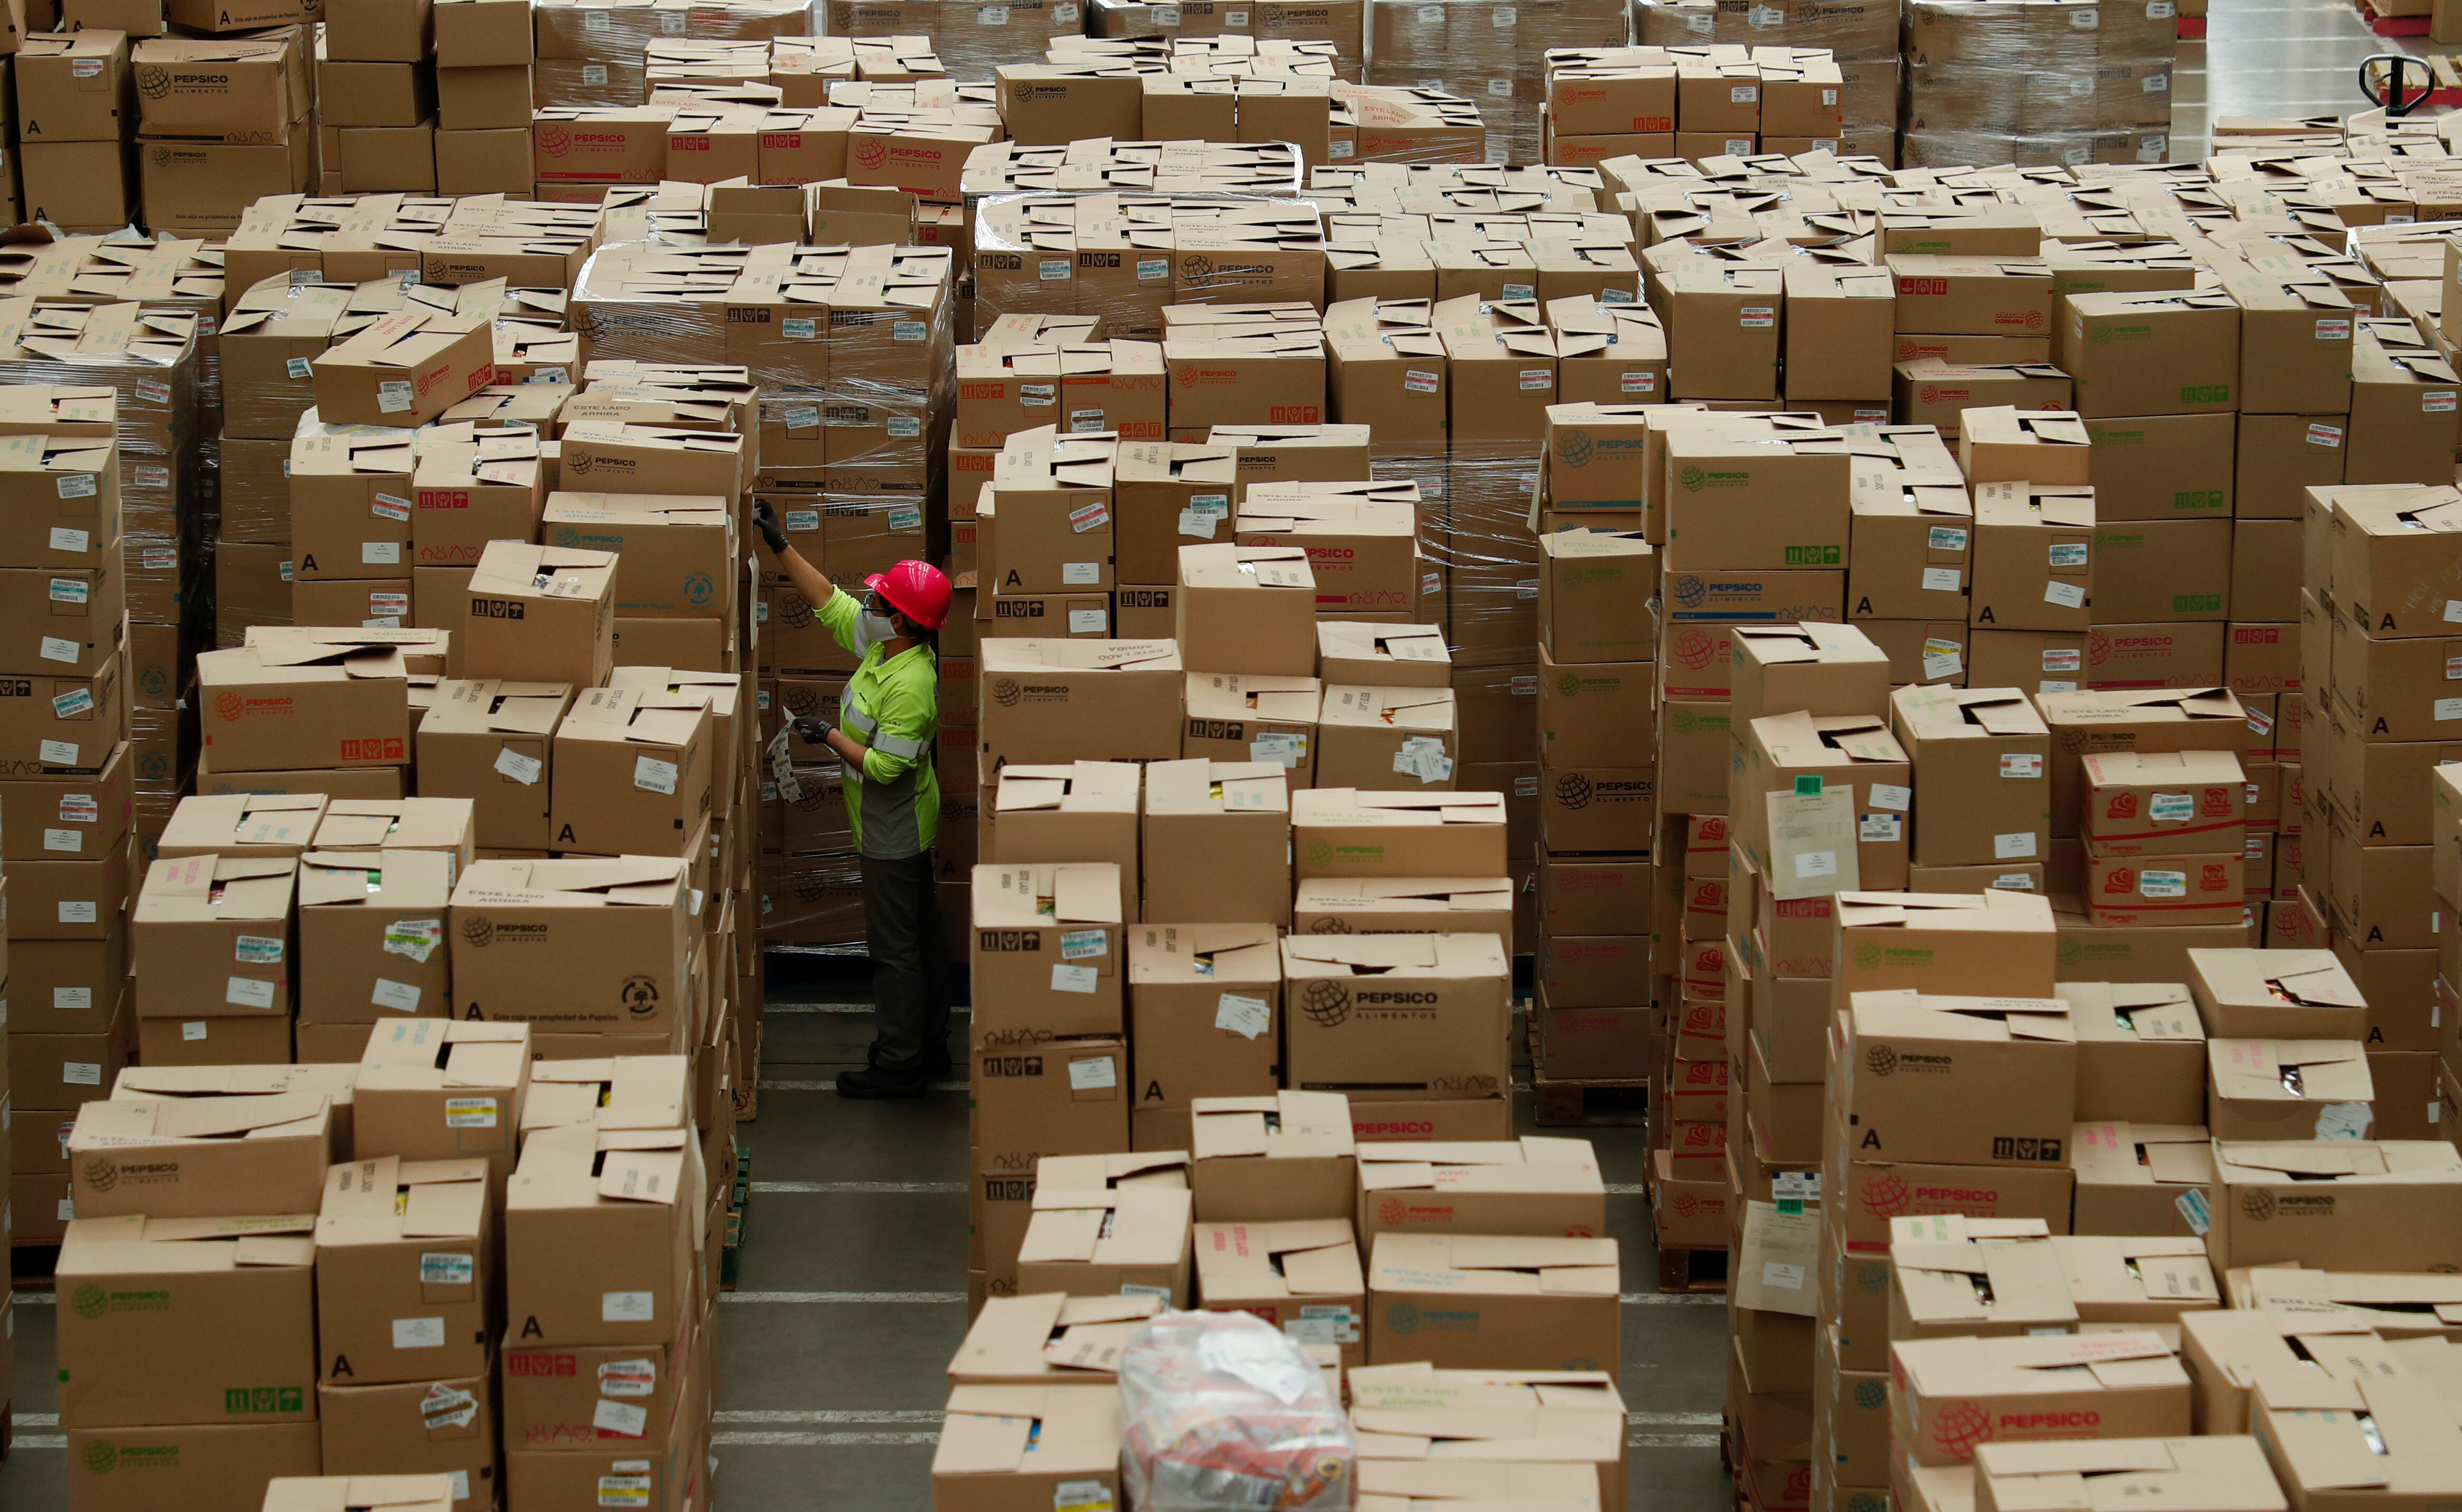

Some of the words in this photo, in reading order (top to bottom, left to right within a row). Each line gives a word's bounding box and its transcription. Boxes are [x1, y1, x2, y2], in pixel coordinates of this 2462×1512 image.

[219, 11, 231, 25] A
[1918, 54, 1928, 64] A
[174, 75, 228, 83] PEPSICO
[1373, 114, 1402, 123] ARRIBA
[1387, 108, 1406, 119] LADO
[27, 120, 41, 134] A
[1915, 118, 1926, 129] A
[574, 134, 626, 143] PEPSICO
[890, 148, 941, 158] PEPSICO
[34, 207, 48, 220] A
[1218, 265, 1274, 274] PEPSICO
[1597, 440, 1643, 449] PEPSIC
[595, 457, 636, 467] PEPSICO
[1308, 549, 1354, 558] PSICO
[301, 554, 318, 571] A
[1005, 569, 1022, 586] A
[1709, 583, 1762, 592] PEPSICO
[1856, 596, 1873, 614] A
[1978, 606, 1995, 623] A
[2380, 613, 2398, 630] A
[2114, 637, 2173, 647] PEPSICO
[2372, 717, 2390, 734] A
[557, 824, 576, 843] A
[2368, 821, 2386, 837] A
[941, 860, 955, 875] A
[2367, 926, 2384, 942] A
[1356, 992, 1438, 1004] PEPSICO
[465, 1003, 483, 1022] A
[2367, 1028, 2384, 1043] A
[1900, 1055, 1952, 1063] PEPSICO
[1144, 1080, 1163, 1101] A
[1354, 1122, 1433, 1134] PEPSICO
[1860, 1129, 1882, 1150] A
[122, 1164, 179, 1173] PEPSICO
[1916, 1187, 1999, 1201] PEPSICO
[2278, 1196, 2335, 1205] PEPSICO
[521, 1315, 543, 1339] A
[331, 1355, 353, 1378] A
[2000, 1411, 2100, 1428] PEPSICO
